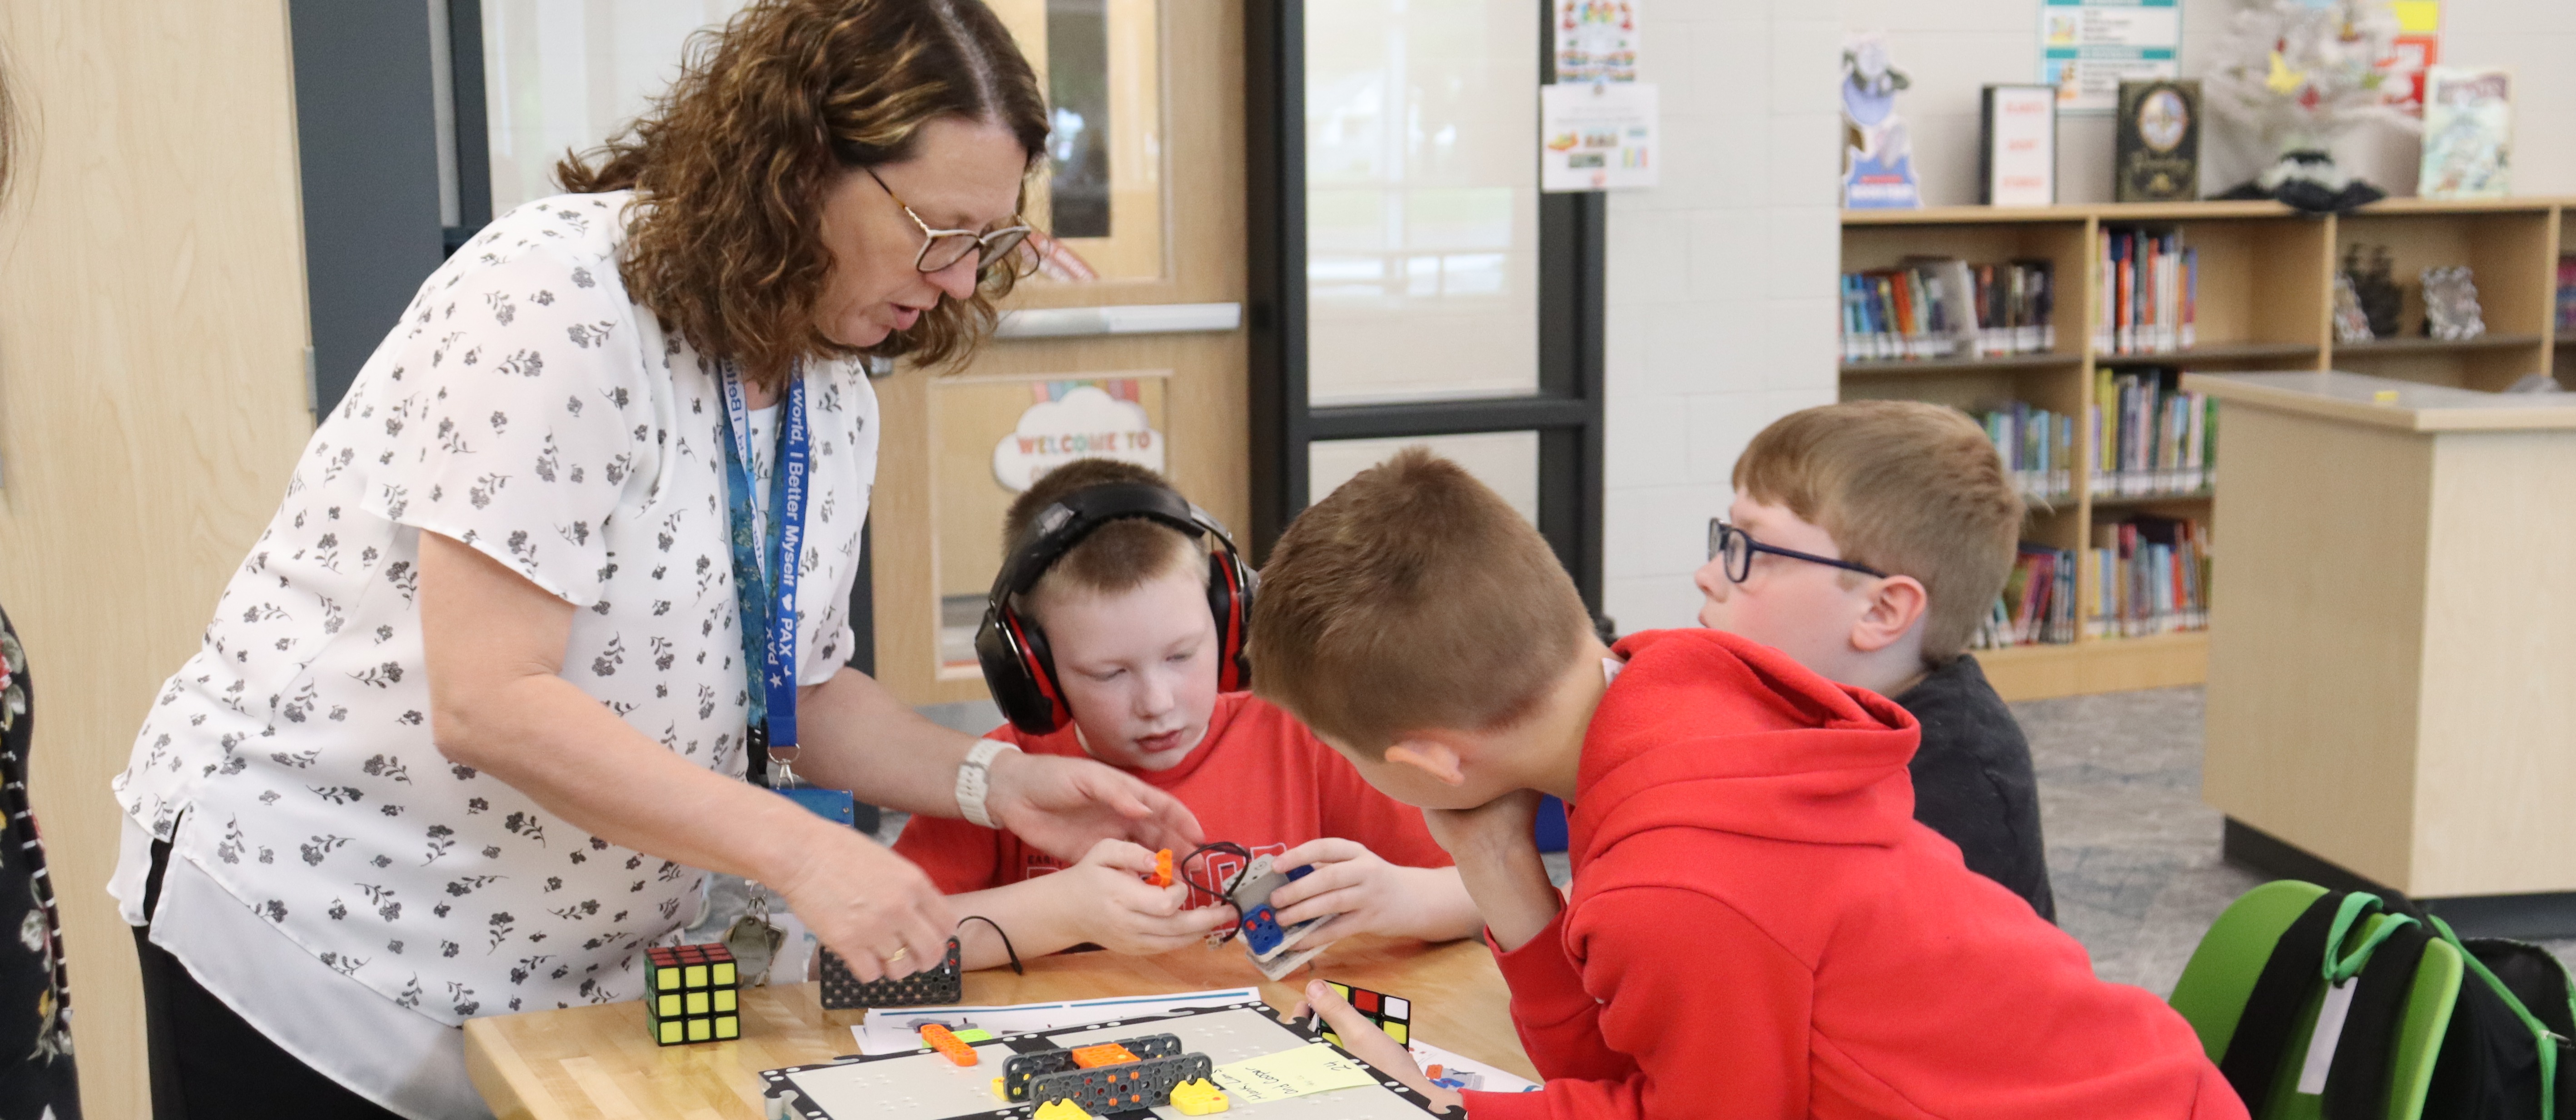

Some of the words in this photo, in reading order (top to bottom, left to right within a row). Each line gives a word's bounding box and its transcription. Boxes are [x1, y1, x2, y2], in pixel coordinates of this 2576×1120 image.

[1017, 432, 1116, 454] WELCOME
[1126, 431, 1150, 450] TO
[787, 462, 804, 520] Better
[782, 525, 800, 587] Myself
[765, 626, 778, 665] PAX
[779, 617, 793, 657] PAX
